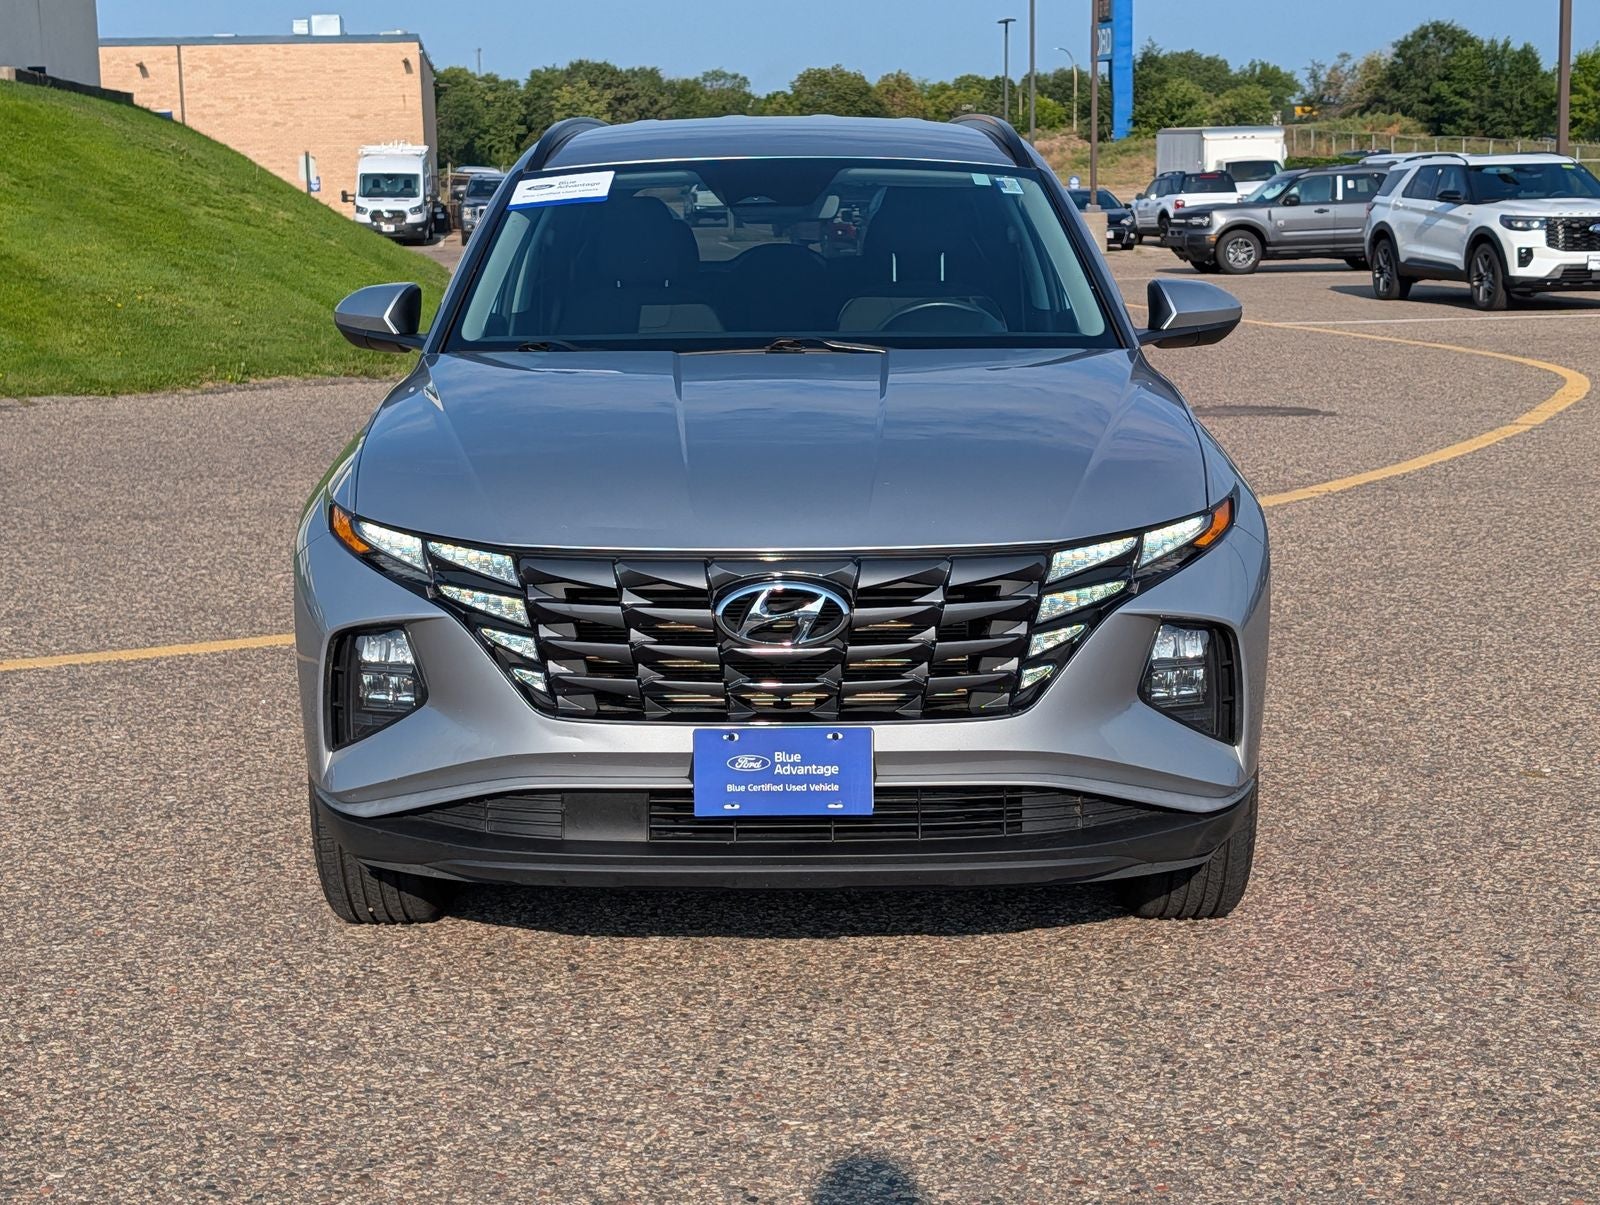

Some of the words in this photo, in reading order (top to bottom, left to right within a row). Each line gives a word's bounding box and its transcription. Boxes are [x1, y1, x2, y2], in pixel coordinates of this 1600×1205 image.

[774, 752, 802, 762] Blue
[735, 757, 763, 770] Ford
[774, 764, 839, 776] Advantage
[727, 783, 746, 792] Blue
[748, 783, 783, 792] Certified
[786, 783, 807, 792] Used
[809, 783, 839, 791] Vehicle
